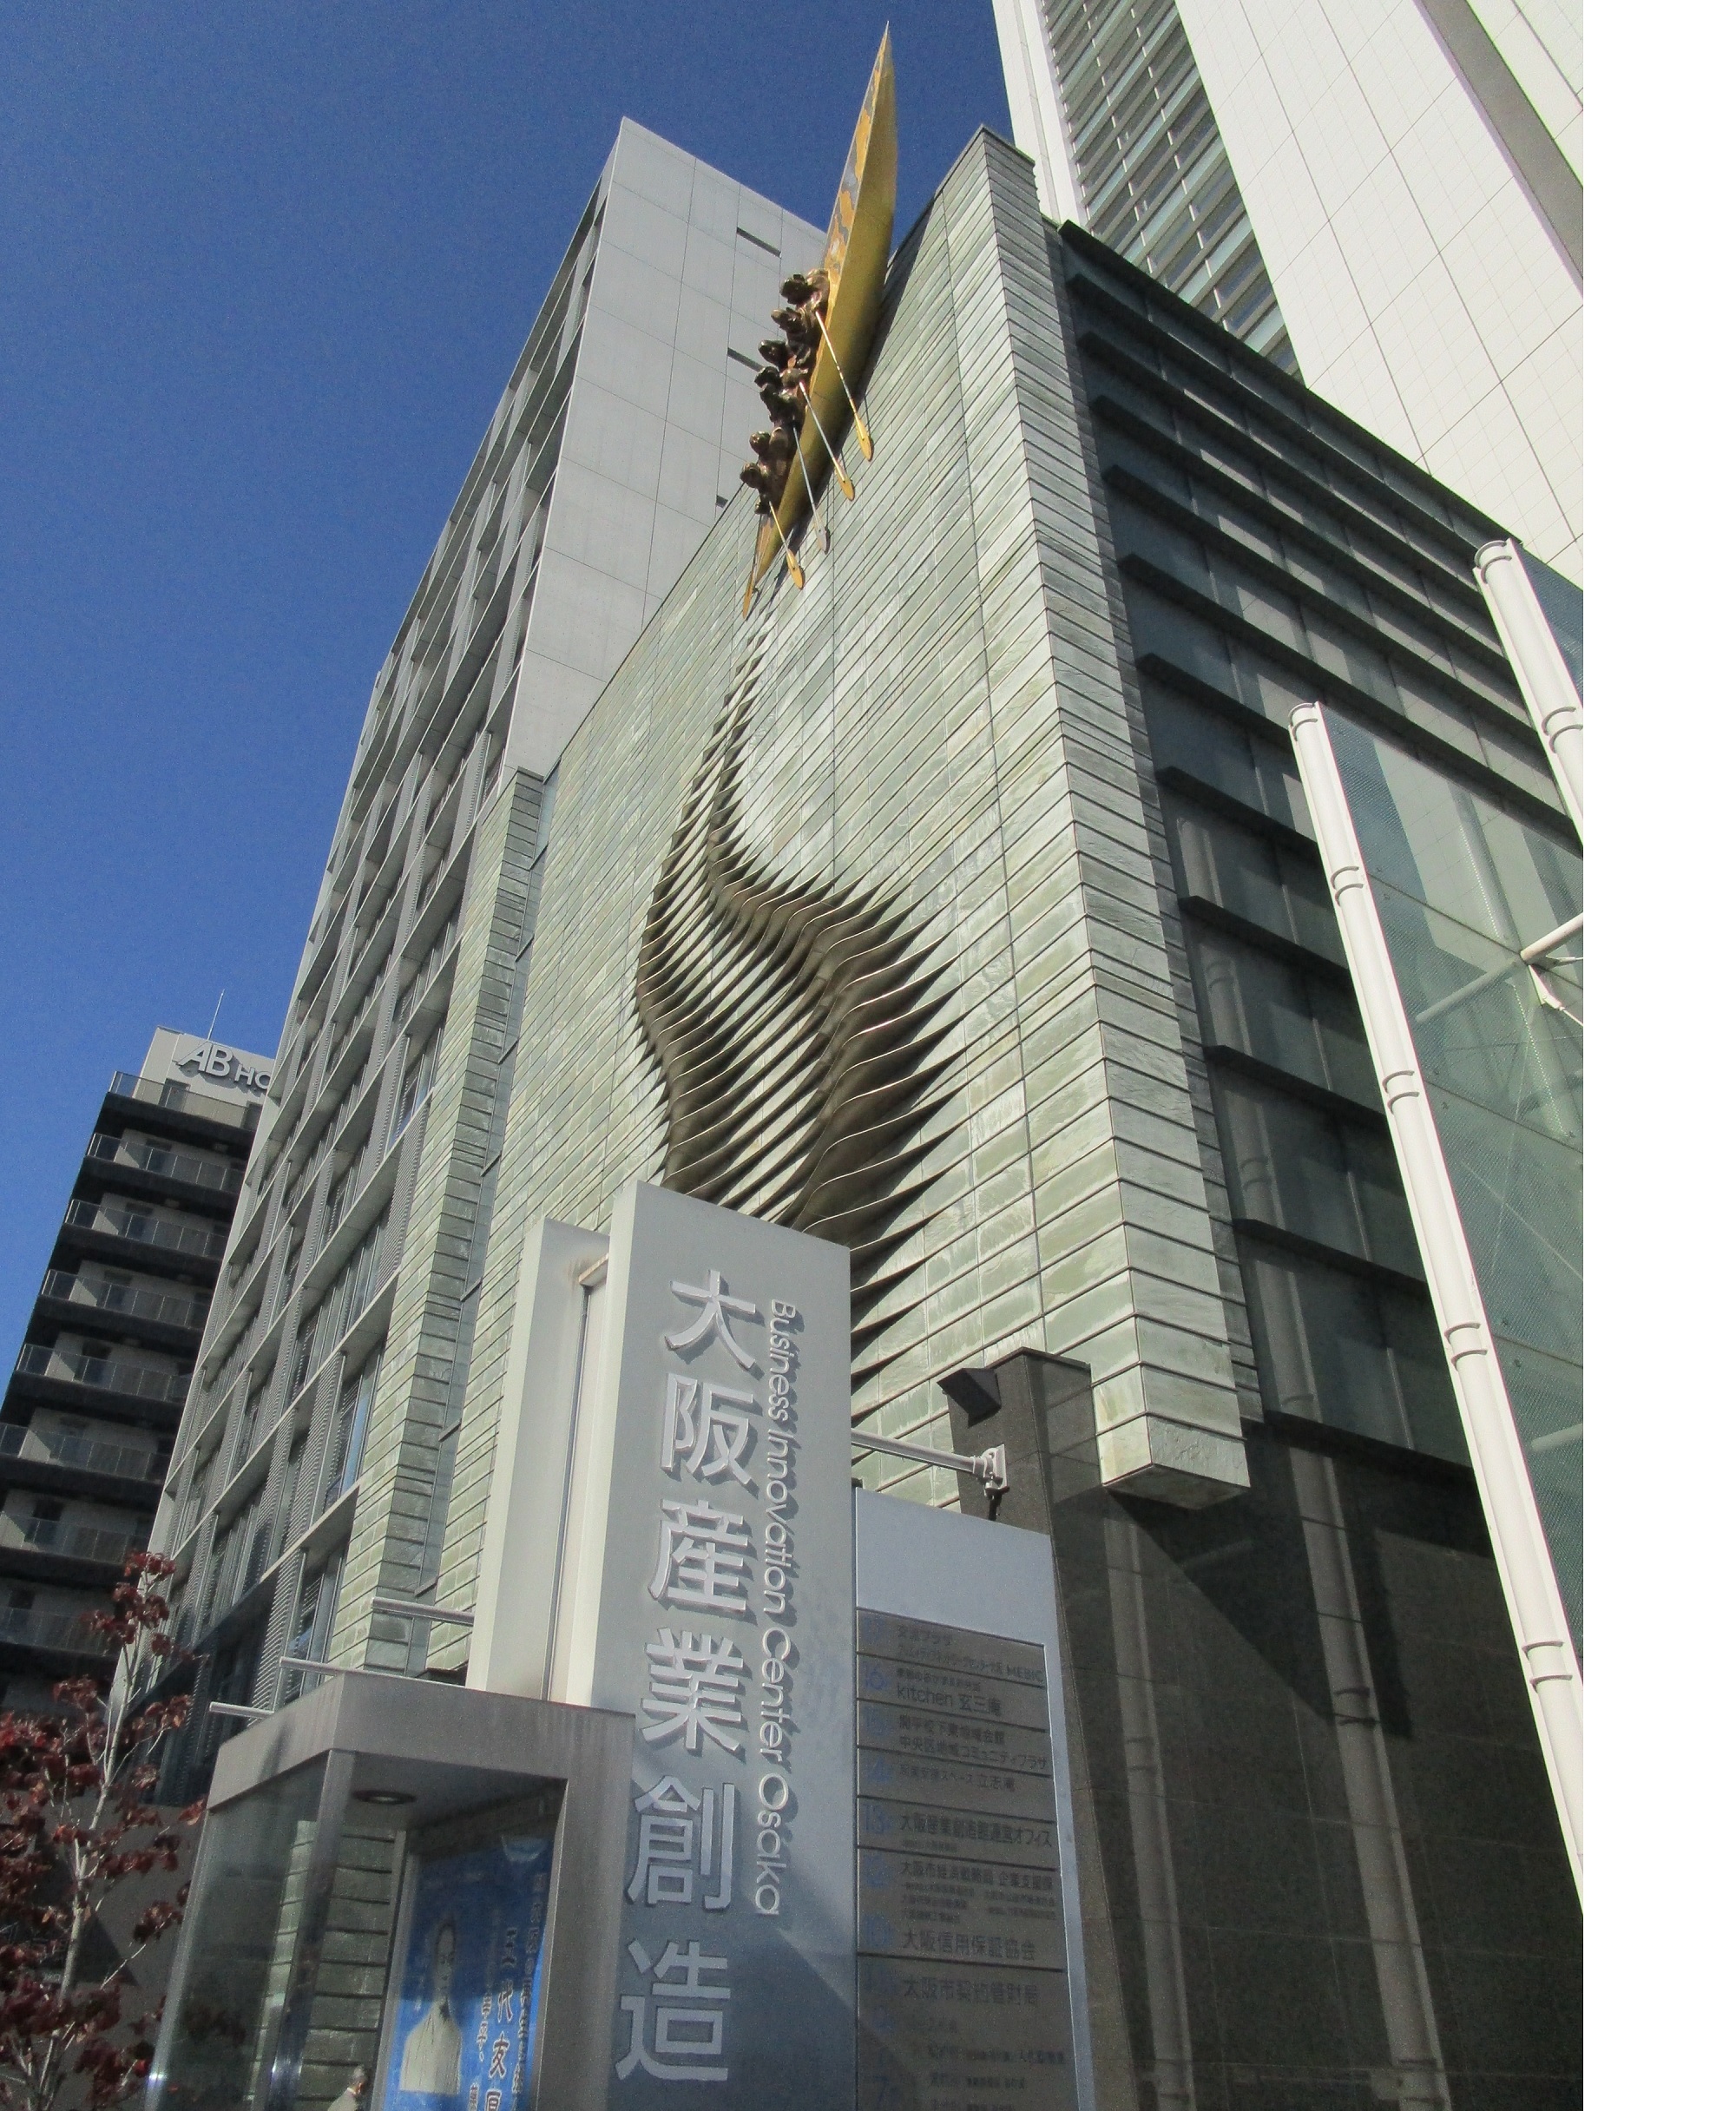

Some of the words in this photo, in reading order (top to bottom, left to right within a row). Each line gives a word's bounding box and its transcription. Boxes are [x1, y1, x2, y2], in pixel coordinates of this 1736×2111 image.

[176, 1041, 233, 1077] AB
[767, 1299, 796, 1422] Business
[762, 1430, 790, 1615] Innovation
[760, 1627, 791, 1764] Center
[897, 1684, 953, 1707] kitchen
[754, 1772, 790, 1917] Osaka
